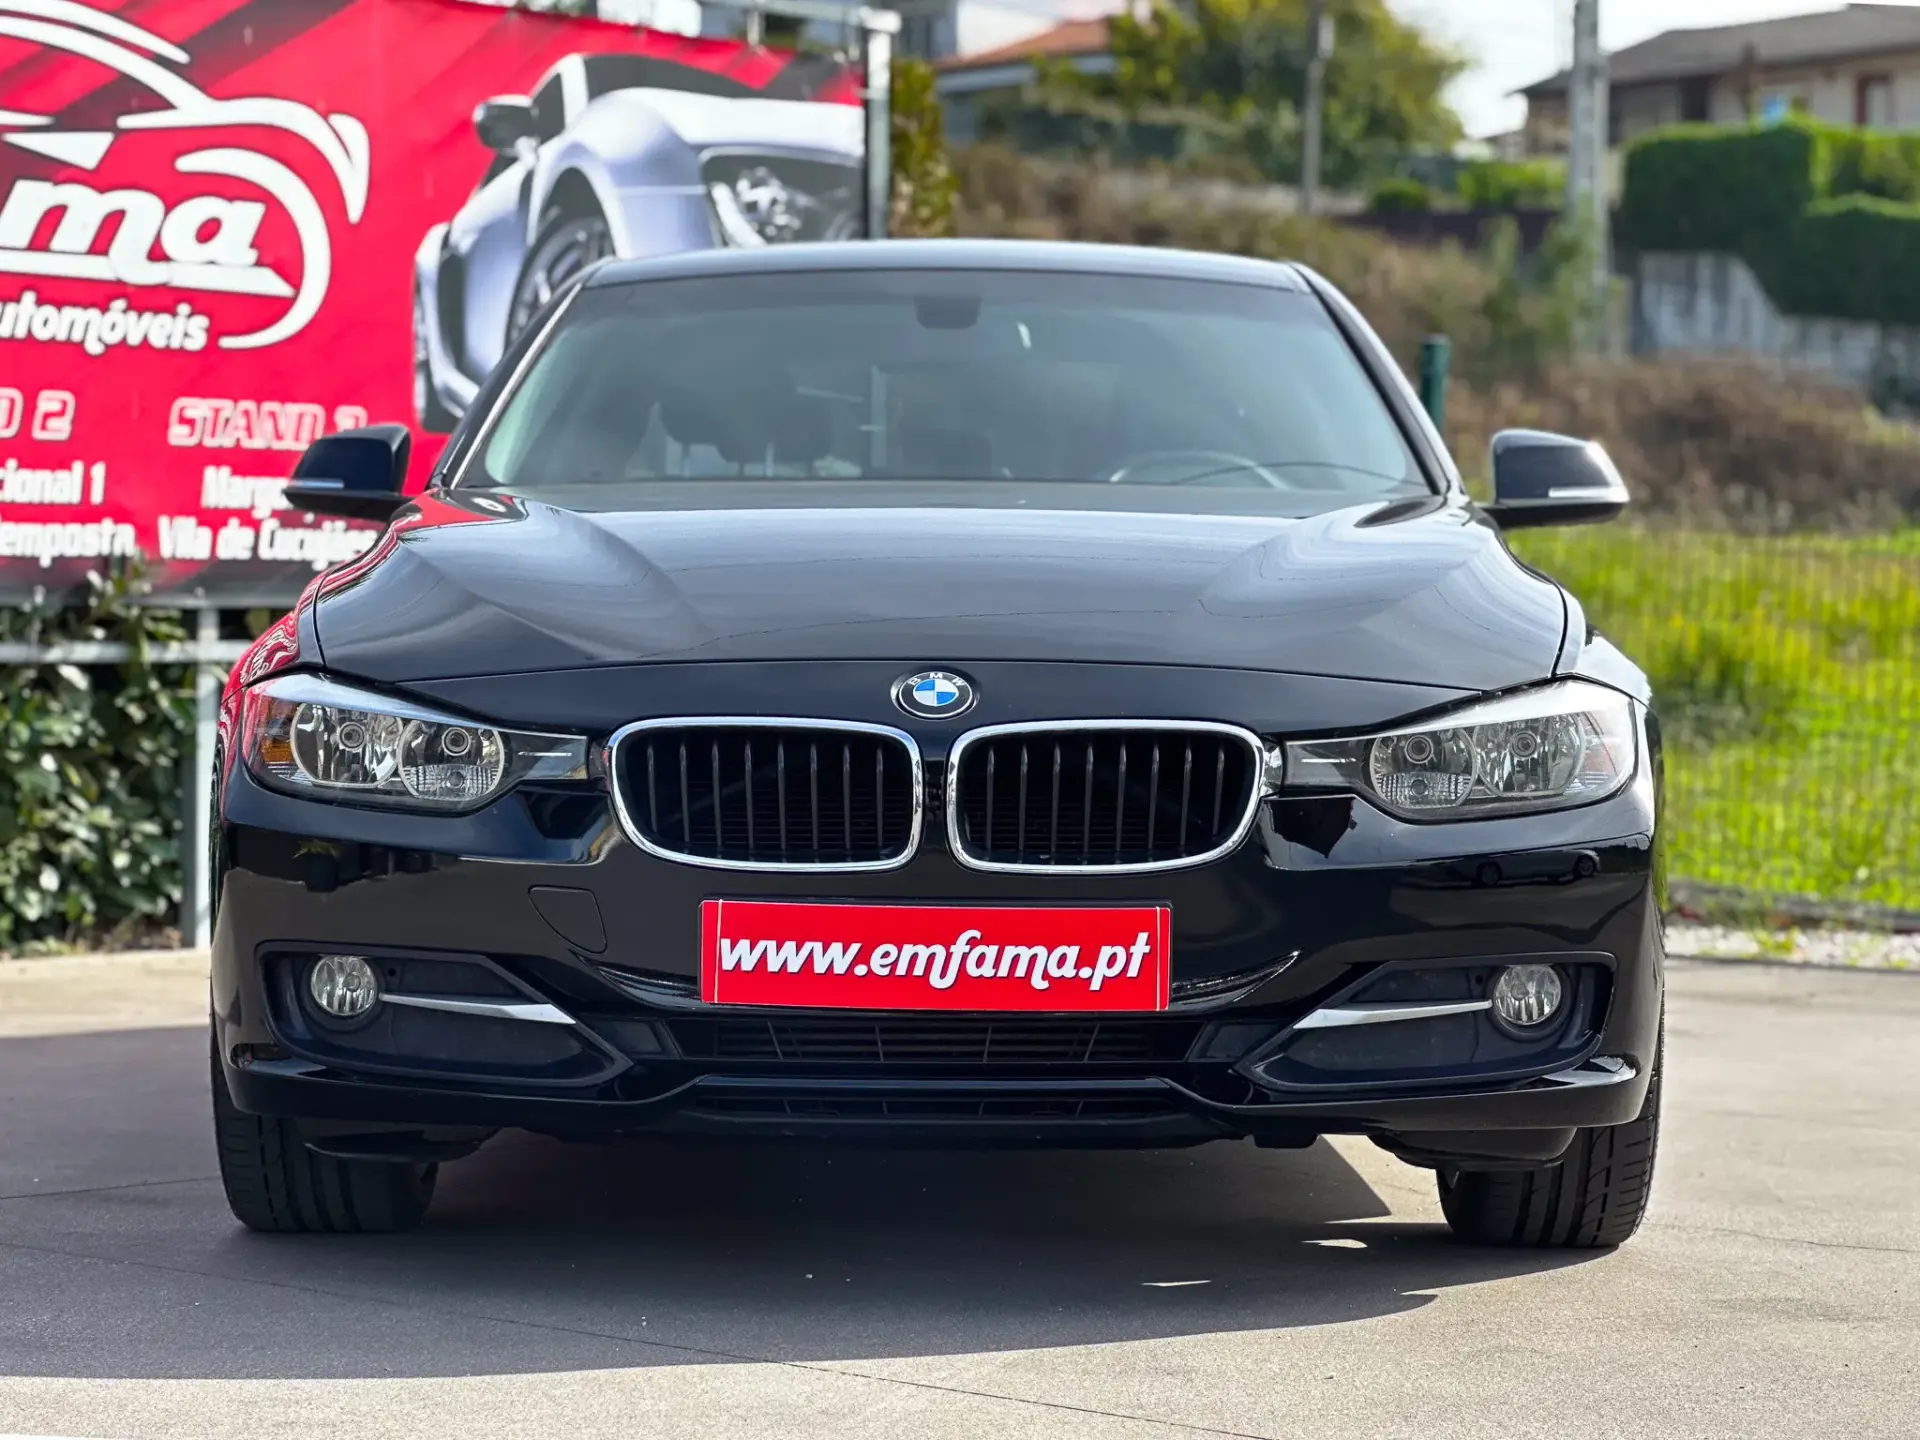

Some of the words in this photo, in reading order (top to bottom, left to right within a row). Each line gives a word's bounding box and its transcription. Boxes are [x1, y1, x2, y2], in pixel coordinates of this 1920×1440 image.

[32, 389, 76, 441] 2
[167, 397, 326, 451] STAND
[90, 460, 106, 505] 1
[157, 515, 213, 559] Vila
[215, 517, 255, 560] de
[907, 672, 966, 686] BMW
[720, 929, 1151, 991] www.emfama.pt
